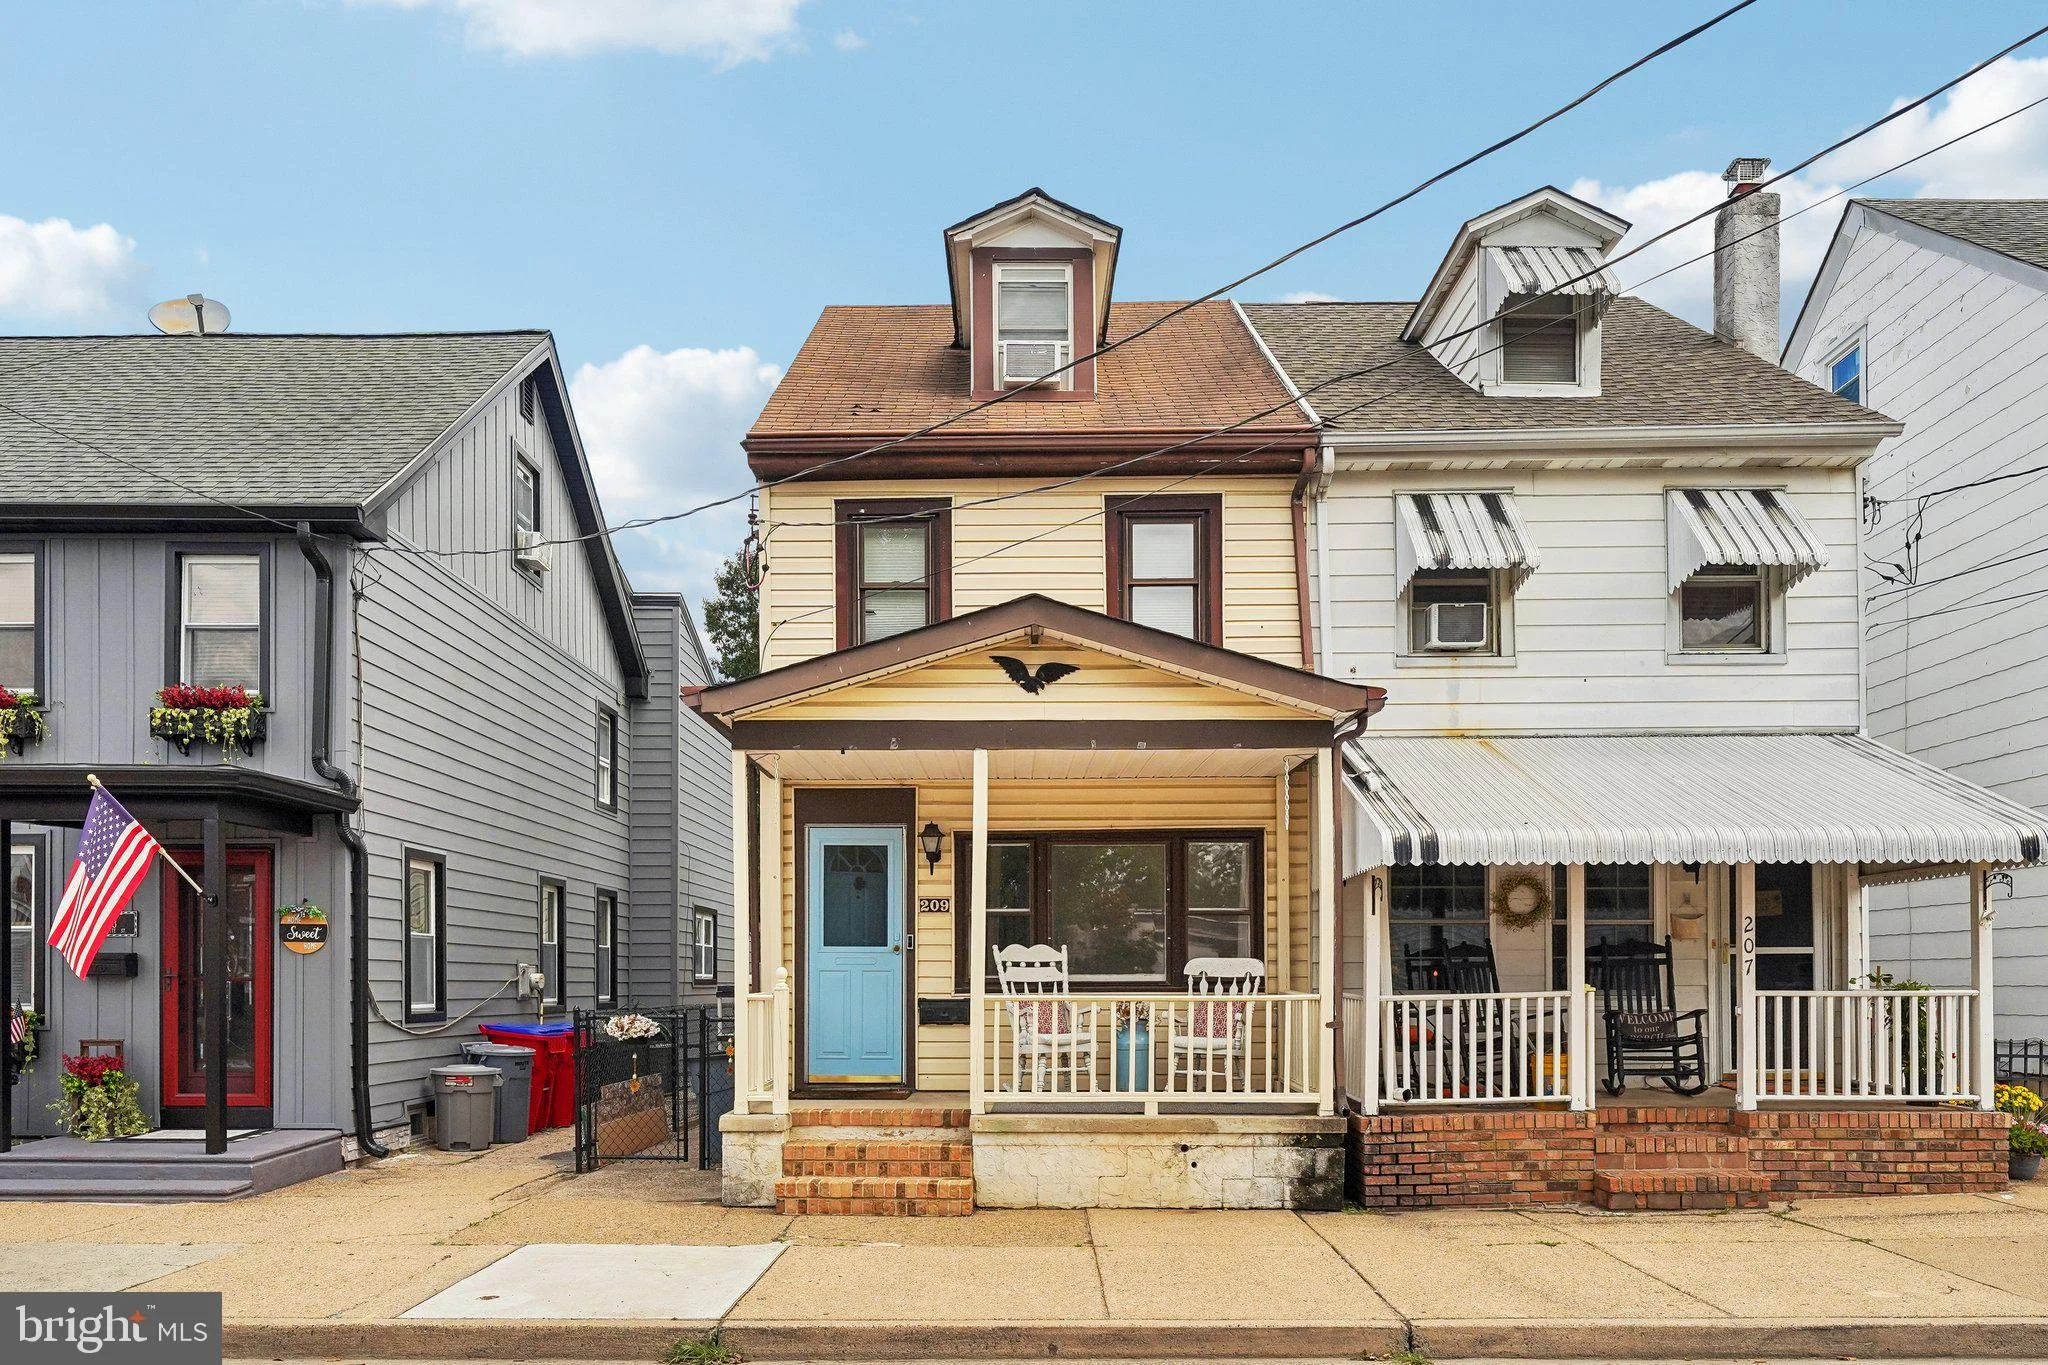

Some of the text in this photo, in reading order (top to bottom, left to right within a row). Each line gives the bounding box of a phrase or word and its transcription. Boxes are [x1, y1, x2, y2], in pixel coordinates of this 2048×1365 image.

[920, 899, 949, 912] 209
[286, 925, 322, 940] Sweet
[1744, 916, 1754, 975] 207
[1633, 1025, 1643, 1033] to
